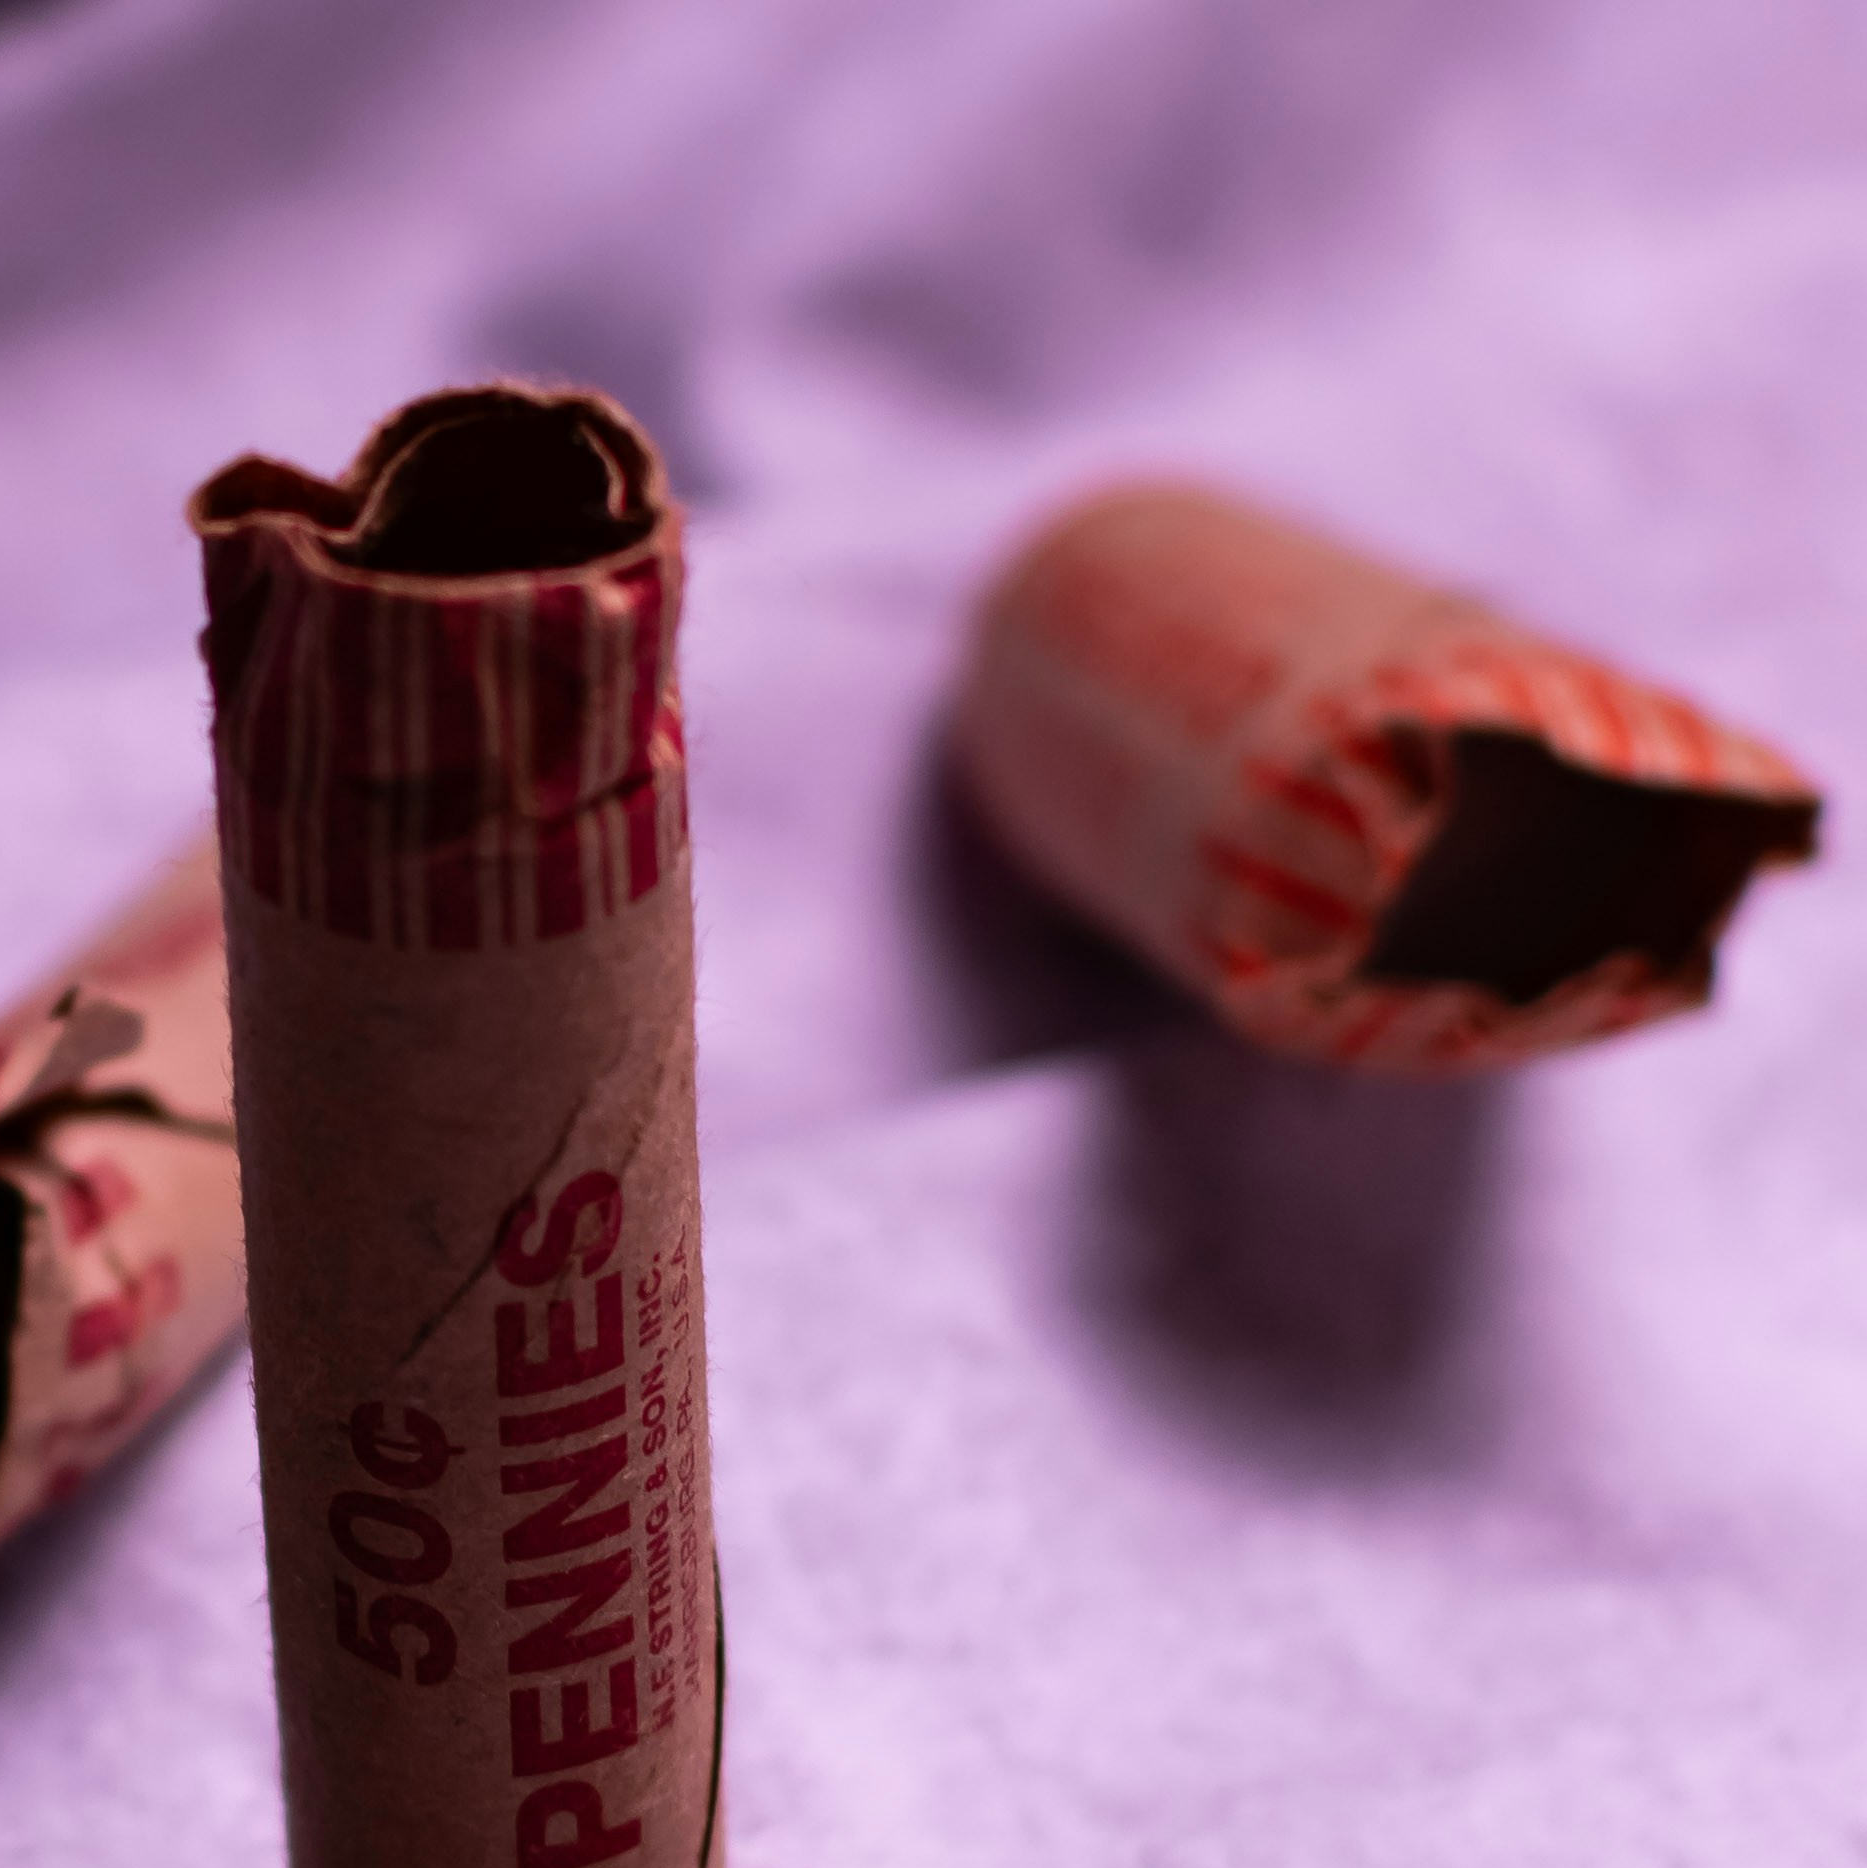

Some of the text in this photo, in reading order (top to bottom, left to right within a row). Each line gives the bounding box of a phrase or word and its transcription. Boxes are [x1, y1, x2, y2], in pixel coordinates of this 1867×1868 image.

[636, 1250, 663, 1348] INC.
[640, 1347, 670, 1457] SON,
[644, 1456, 668, 1493] &
[645, 1497, 674, 1656] STRING
